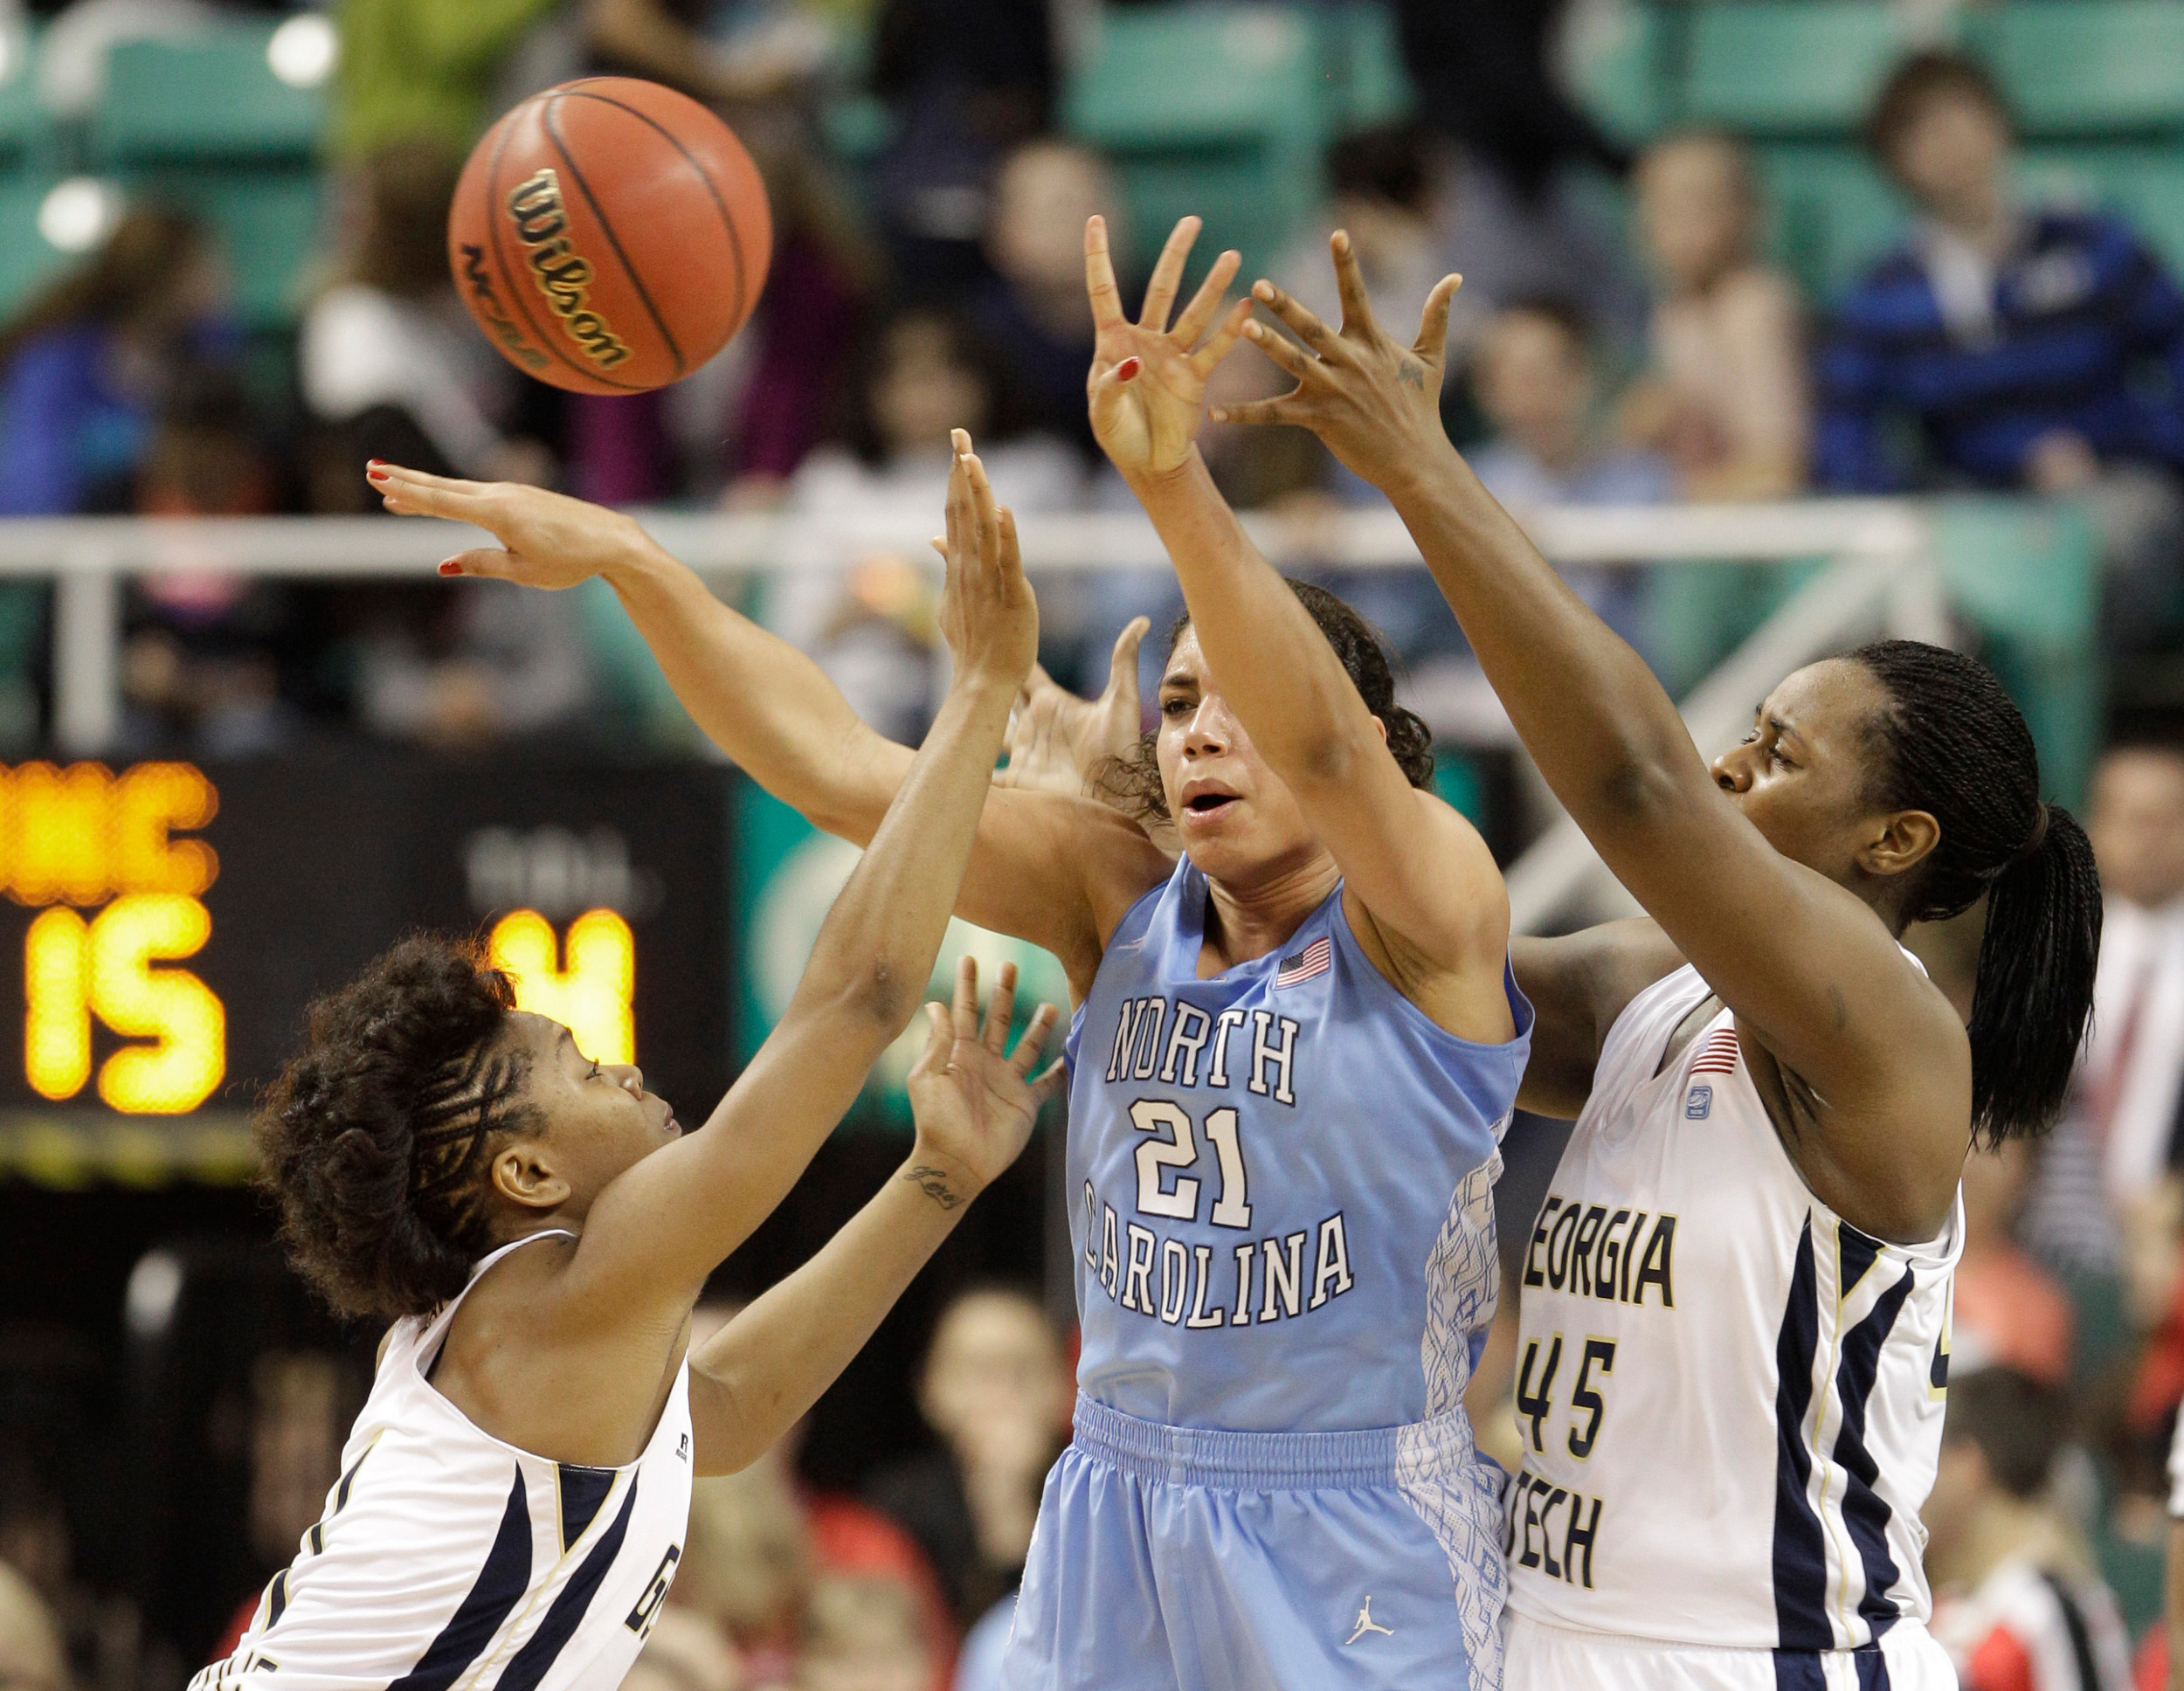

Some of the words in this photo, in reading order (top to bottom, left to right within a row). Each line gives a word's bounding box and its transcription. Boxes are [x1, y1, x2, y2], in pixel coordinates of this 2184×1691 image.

[508, 167, 632, 370] Wilson
[24, 893, 225, 1115] 15
[1105, 996, 1300, 1107] NORTH
[1129, 1097, 1253, 1230] 21
[1084, 1179, 1354, 1330] CAROLINA
[1523, 1194, 1678, 1310] EORGIA
[1515, 1331, 1617, 1466] 45
